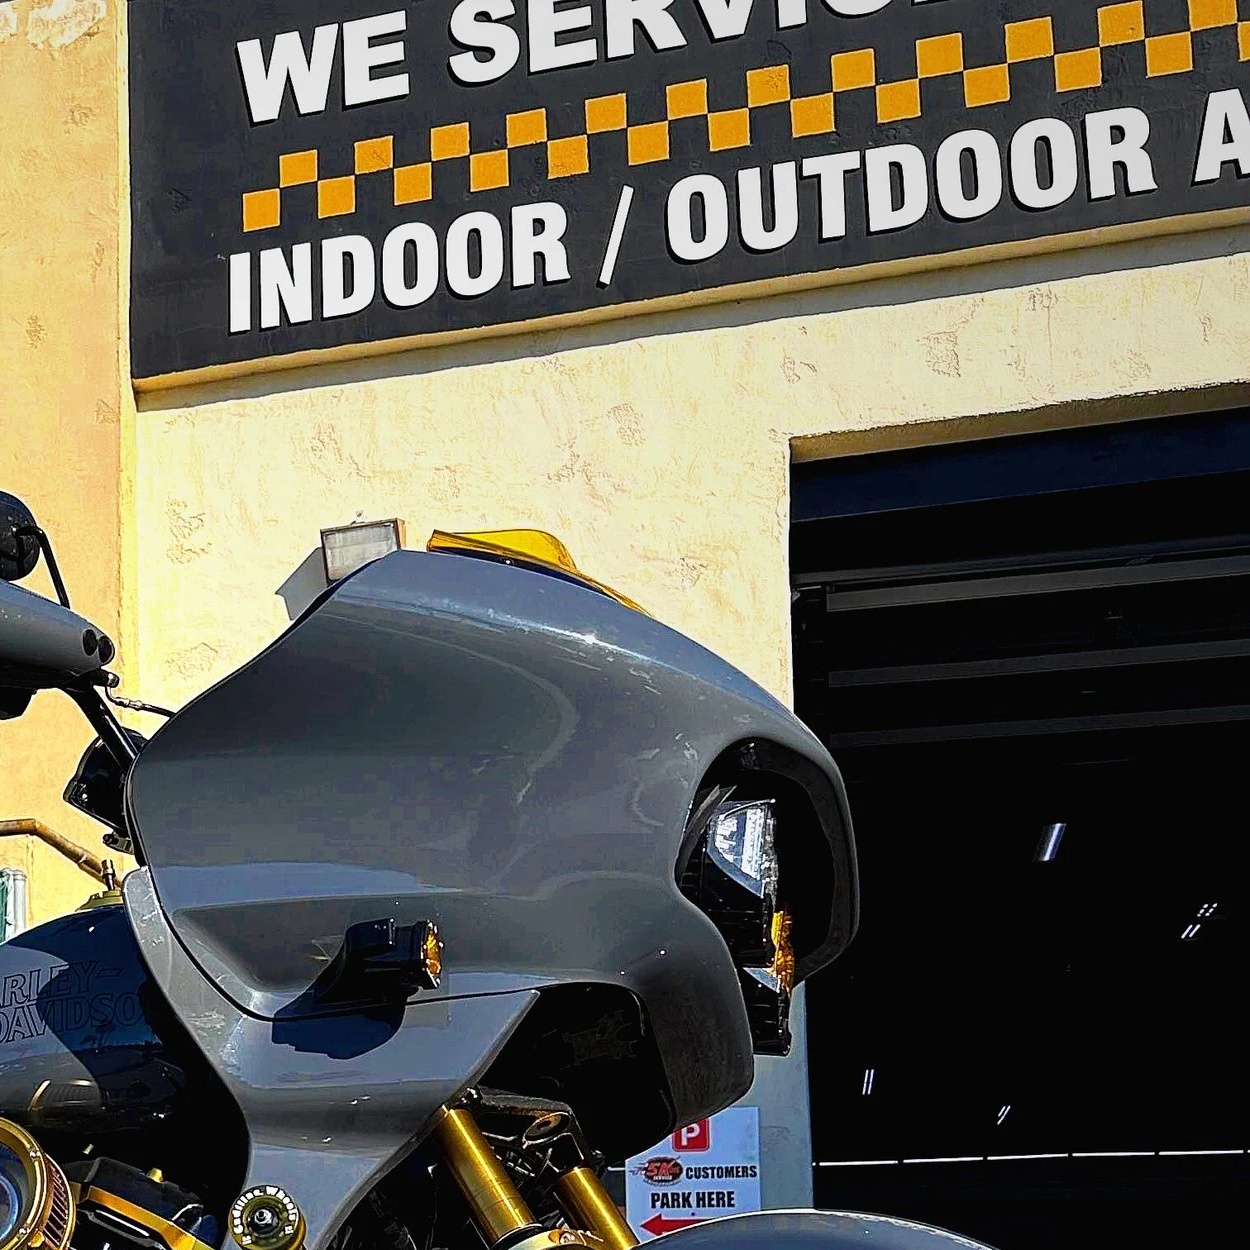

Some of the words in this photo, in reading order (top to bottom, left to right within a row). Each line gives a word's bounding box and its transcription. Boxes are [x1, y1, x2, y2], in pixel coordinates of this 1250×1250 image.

[237, 10, 410, 123] WE
[229, 201, 572, 334] INDOOR
[664, 106, 1158, 266] OUTDOOR
[681, 1123, 700, 1146] P
[685, 1165, 758, 1180] CUSTOMERS
[650, 1191, 693, 1209] PARK
[695, 1190, 735, 1208] HERE
